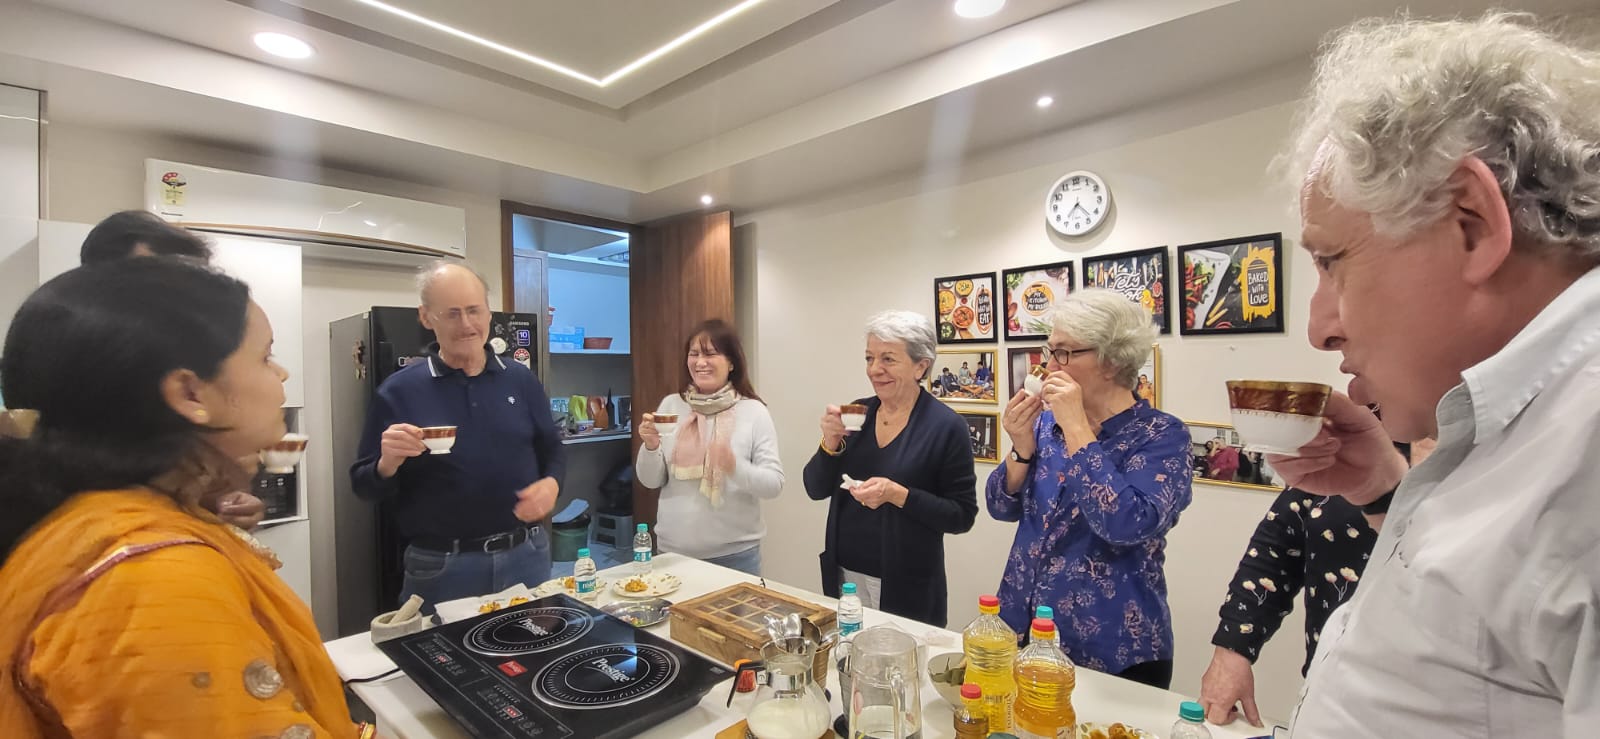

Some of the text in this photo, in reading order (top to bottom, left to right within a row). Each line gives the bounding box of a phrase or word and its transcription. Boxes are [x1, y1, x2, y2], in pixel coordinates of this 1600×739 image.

[1072, 177, 1080, 186] 12
[1055, 193, 1063, 201] 10
[1097, 196, 1102, 204] 3
[1053, 204, 1058, 212] 9
[1056, 214, 1062, 222] 8
[1075, 222, 1080, 230] 6
[1248, 272, 1269, 285] BAKED
[1252, 284, 1264, 293] WITH
[979, 312, 990, 325] EAT
[519, 331, 528, 339] 10
[592, 657, 630, 682] Prestige
